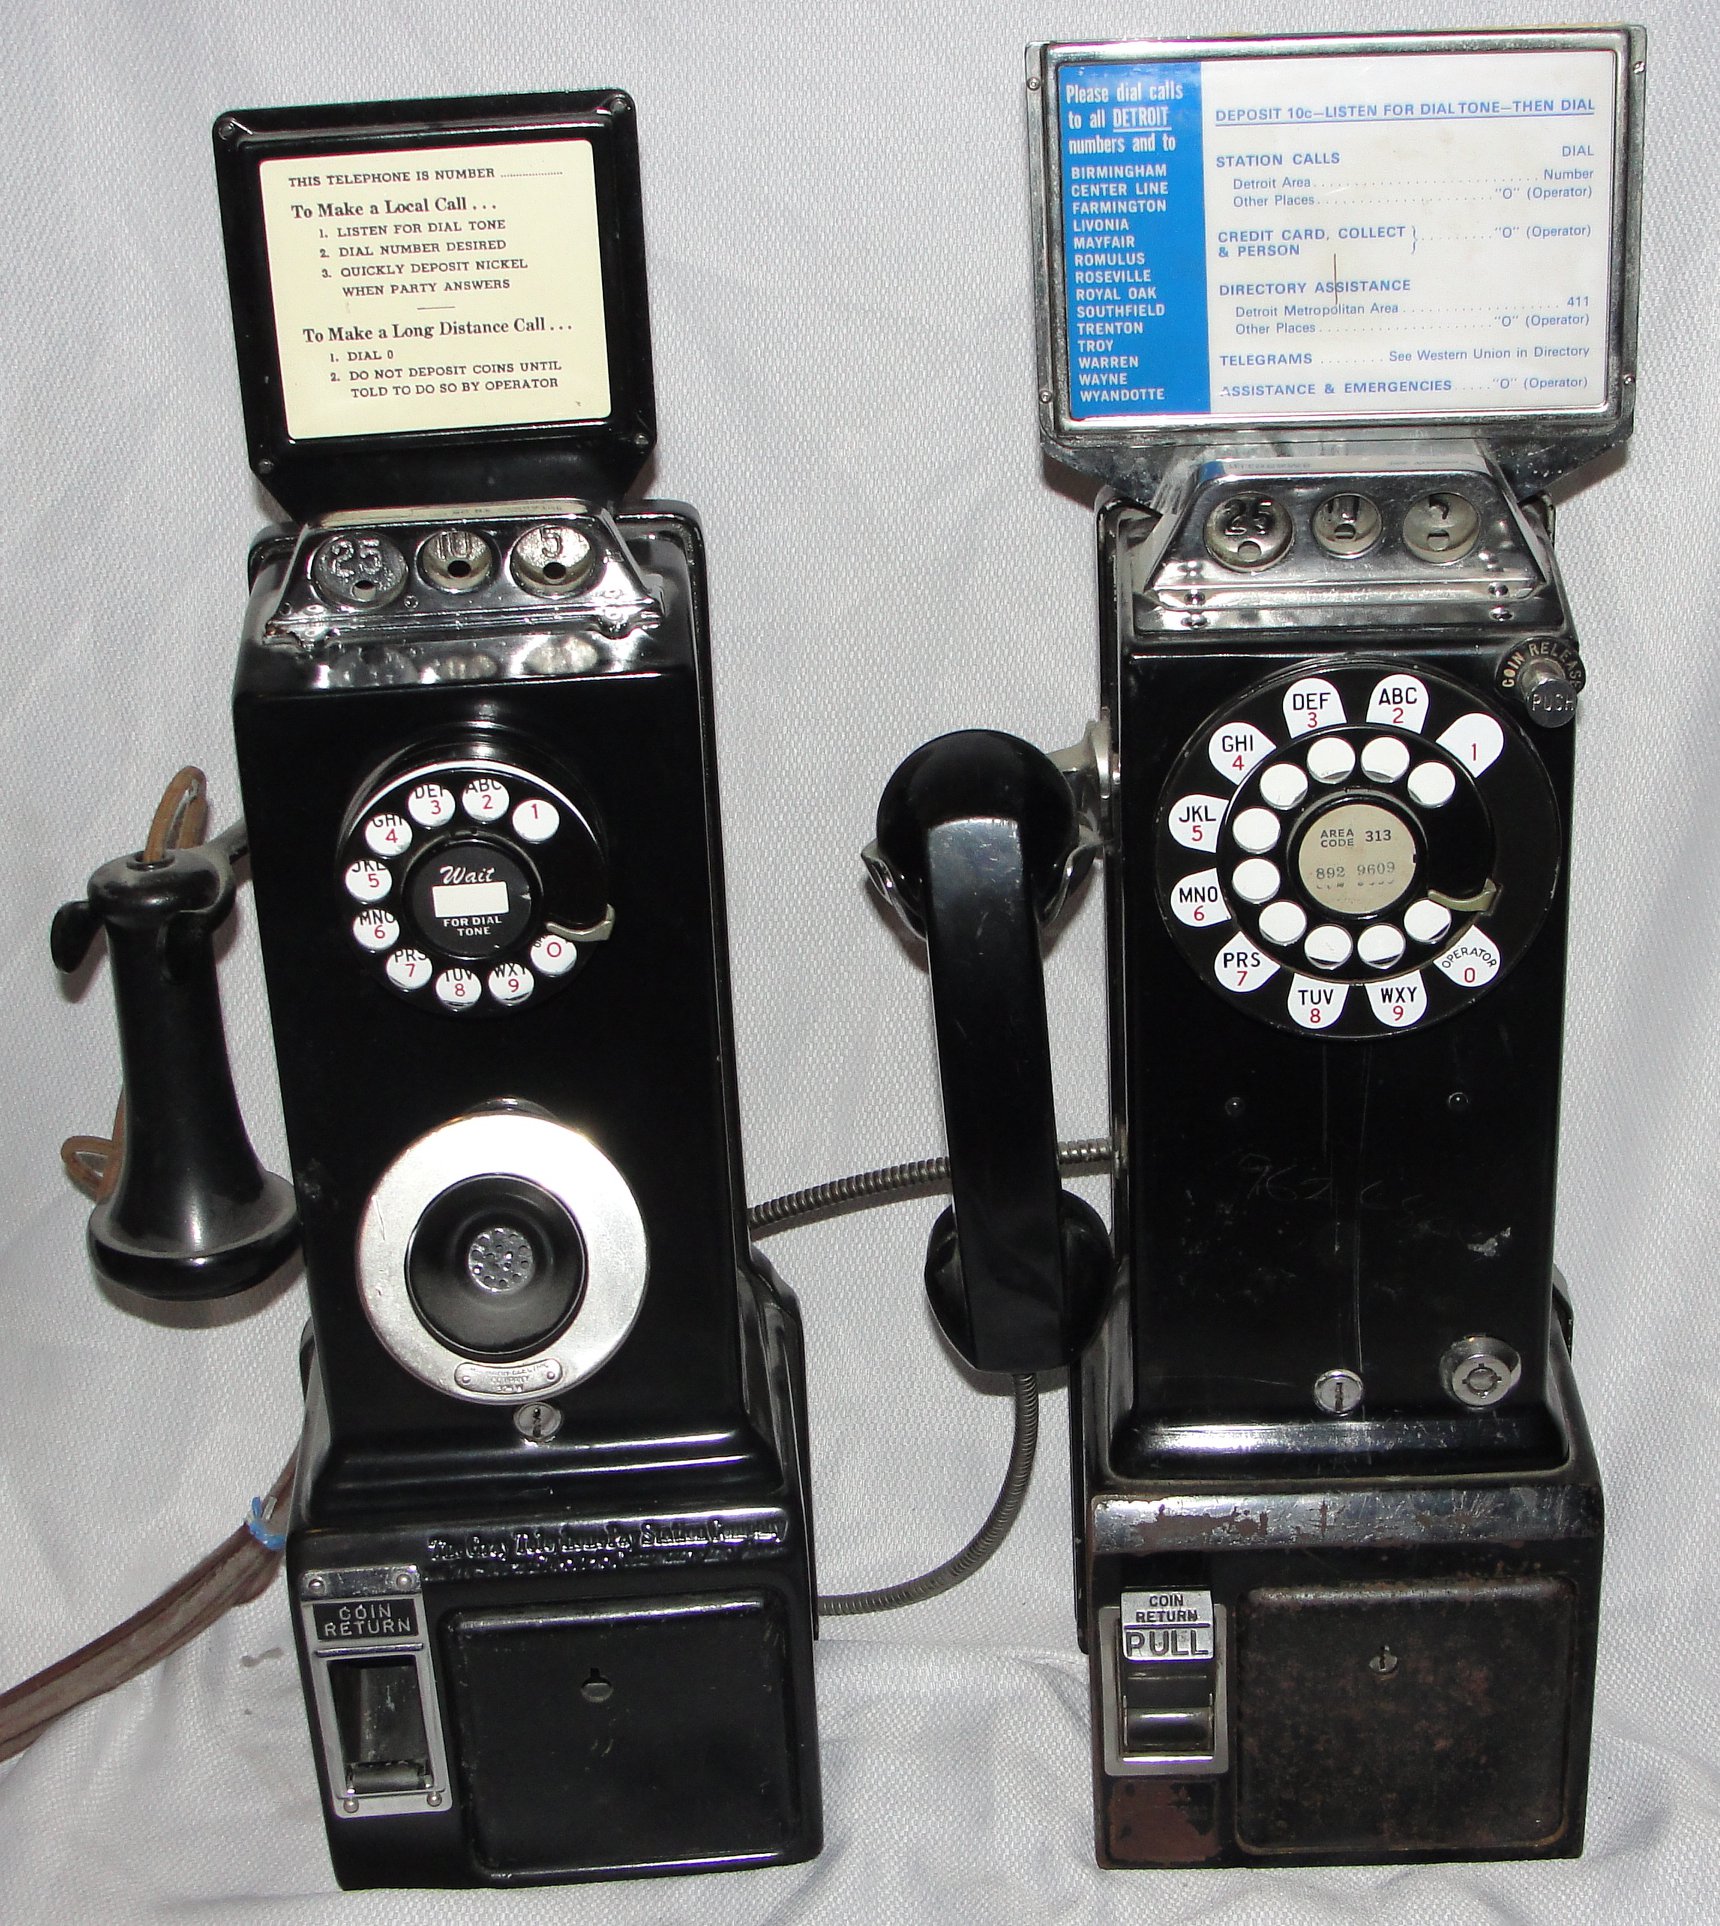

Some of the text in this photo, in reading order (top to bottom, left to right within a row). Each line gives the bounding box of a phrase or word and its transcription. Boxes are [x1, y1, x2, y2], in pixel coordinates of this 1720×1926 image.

[1066, 80, 1184, 104] Please dial calls
[1215, 98, 1595, 122] DEPOSIT FOR DIAL
[1068, 107, 1170, 130] to all DETROIT
[1068, 132, 1176, 155] numbers and to
[1562, 145, 1594, 157] DIAL
[1216, 152, 1340, 167] STATION CALLS
[288, 168, 495, 187] THIS TELEPHONE IS NUMBER
[1071, 164, 1167, 180] BIRMINGHAM
[1233, 177, 1276, 190] Detroit
[1543, 168, 1594, 180] Number
[1071, 182, 1168, 197] CENTER LINE
[1233, 196, 1268, 207] Other
[1527, 186, 1592, 200] (Operator)
[291, 204, 312, 219] To
[317, 202, 364, 217] Make
[370, 205, 379, 215] a
[385, 198, 429, 214] Local
[1072, 200, 1167, 215] FARMINGTON
[337, 220, 506, 237] LISTEN FOR DIAL TONE
[1073, 219, 1130, 232] LIVONIA
[1218, 225, 1591, 243] CREDIT CARD, COLLECT (Operator)
[339, 240, 506, 257] DIAL NUMBER DESIRED
[1073, 236, 1135, 249] MAYFAIR
[1218, 244, 1300, 257] & PERSON
[1074, 253, 1146, 266] ROMULUS
[340, 259, 528, 277] QUICKLY DEPOSIT NICKEL
[1075, 270, 1151, 284] ROSEVILLE
[342, 279, 510, 297] WHEN PARTY ANSWERS
[1076, 287, 1157, 301] ROYAL OAK
[1219, 280, 1411, 296] DIRECTORY ASSISTANCE
[1076, 304, 1166, 318] SOUTHFIELD
[1235, 306, 1278, 318] Detroit
[1284, 304, 1365, 318] Metropolitan
[1567, 296, 1590, 307] 411
[303, 328, 324, 343] To
[328, 326, 373, 341] Make
[378, 328, 388, 339] a
[392, 323, 434, 339] Long
[440, 321, 509, 336] Distance
[1077, 322, 1144, 336] TRENTON
[1235, 323, 1269, 334] Other
[1525, 314, 1590, 328] (Operator)
[1078, 340, 1114, 352] TROY
[347, 351, 382, 362] DIAL
[1078, 356, 1139, 369] WARREN
[1220, 346, 1590, 366] TELEGRAMS See Western Union in Directory
[349, 361, 562, 381] DO NOT DEPOSIT COINS UNTIL
[1079, 373, 1127, 386] WAYNE
[1324, 383, 1335, 394] &
[1344, 380, 1452, 394] EMERGENCIES
[1524, 377, 1588, 391] (Operator)
[351, 378, 559, 398] TOLD TO DO SO BY OPERATOR
[1080, 388, 1165, 402] WYANDOTTE
[540, 526, 562, 558] 5
[332, 537, 381, 576] 25
[1502, 652, 1525, 688] COIN
[1293, 693, 1331, 711] DEF
[1378, 687, 1418, 706] ABC
[1306, 712, 1318, 728] 3
[1392, 707, 1404, 725] 2
[1222, 736, 1254, 752] GHI
[1471, 743, 1478, 761] 1
[1232, 755, 1244, 771] 4
[431, 800, 441, 815] 3
[482, 795, 493, 809] 2
[531, 804, 539, 820] 1
[1179, 806, 1216, 823] JKL
[385, 829, 398, 843] 4
[1191, 825, 1203, 842] 5
[1320, 829, 1391, 842] AREA 313
[1321, 838, 1354, 847] CODE
[440, 866, 495, 884] Wait
[1316, 861, 1395, 879] 892 9609
[368, 873, 380, 888] 5
[1179, 886, 1218, 903] MNO
[443, 916, 502, 927] FOR DIAL
[1194, 905, 1205, 922] 6
[374, 925, 385, 939] 6
[457, 927, 491, 936] TONE
[1223, 951, 1260, 968] PRS
[1441, 948, 1498, 969] OPERATOR
[405, 963, 415, 977] 7
[1236, 970, 1249, 986] 7
[455, 983, 466, 997] 8
[508, 978, 519, 993] 9
[1297, 989, 1334, 1005] TUV
[1380, 987, 1417, 1003] WXY
[1310, 1008, 1321, 1024] 8
[1393, 1005, 1404, 1021] 9
[1149, 1594, 1183, 1607] COIN
[339, 1603, 391, 1620] COIN
[1136, 1609, 1198, 1622] RETURN
[324, 1618, 411, 1636] RETURN
[1125, 1629, 1209, 1657] PULL
